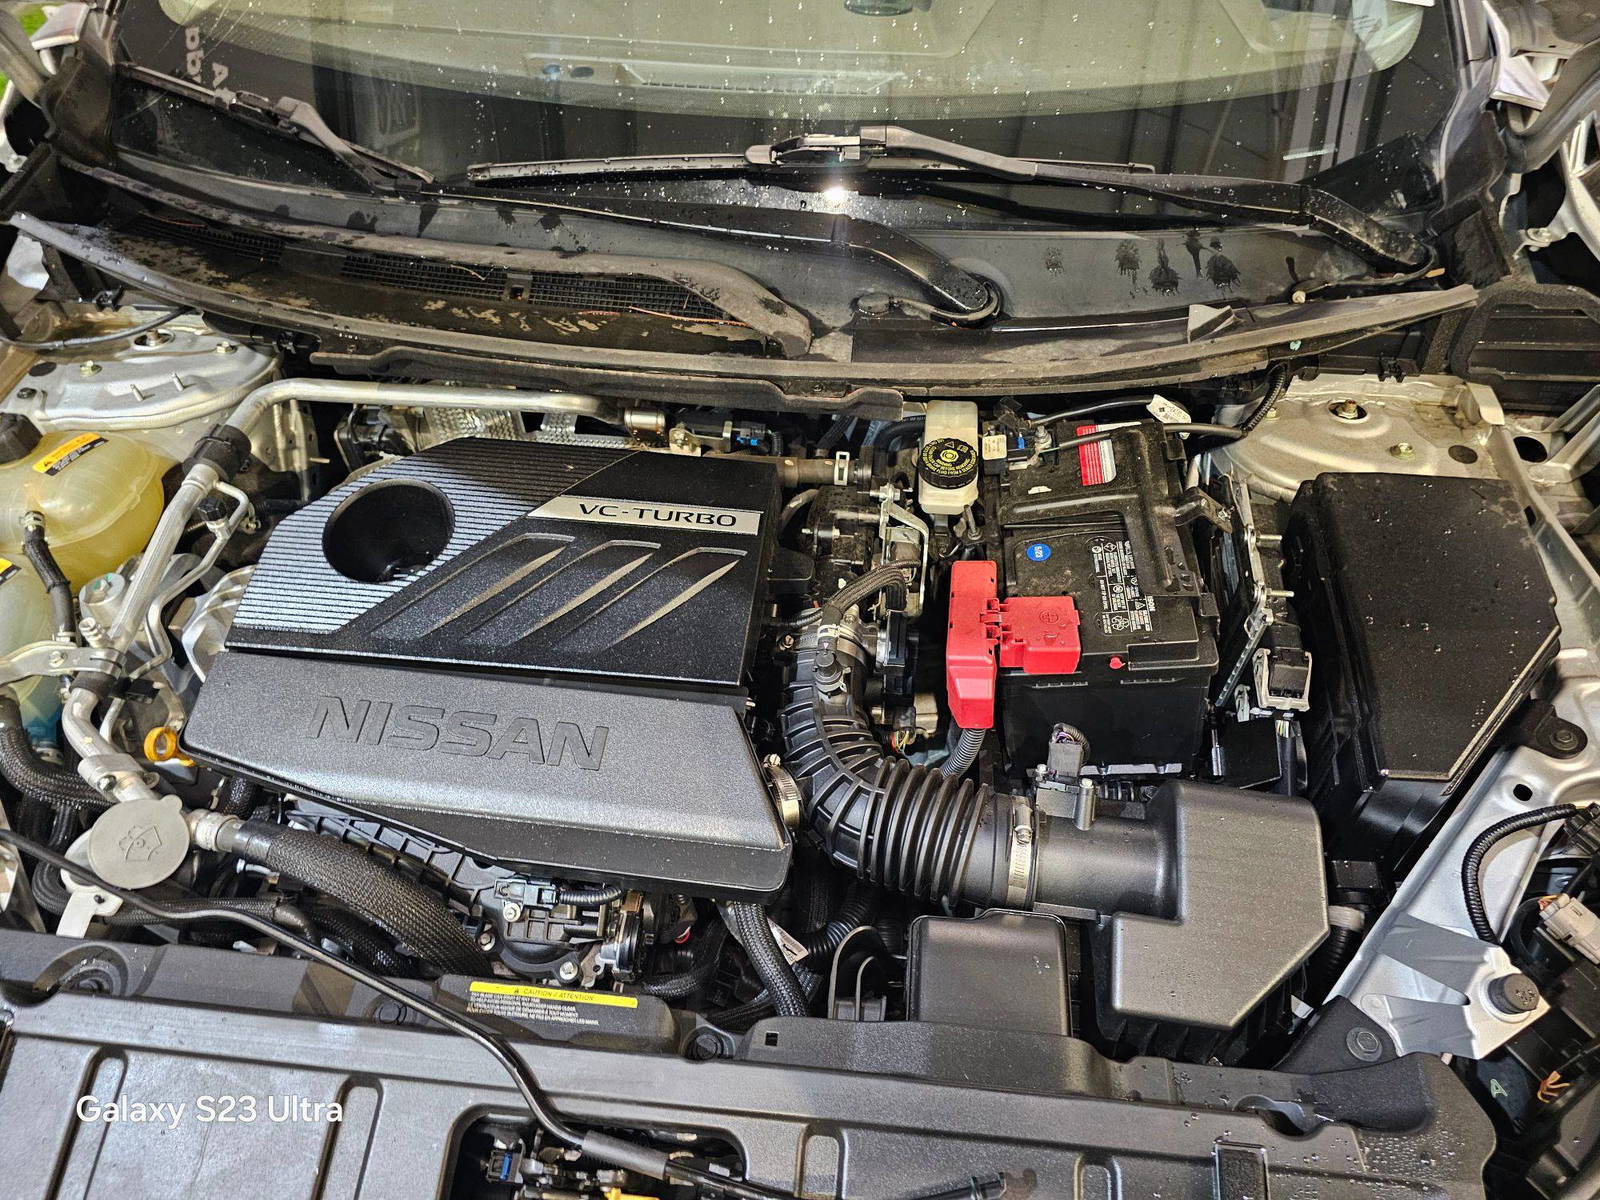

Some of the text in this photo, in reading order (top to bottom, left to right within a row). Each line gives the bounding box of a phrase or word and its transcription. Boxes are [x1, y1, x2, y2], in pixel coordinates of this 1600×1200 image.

[579, 503, 737, 527] VC-TURBO
[304, 695, 610, 772] NISSAN
[523, 987, 553, 997] CAUTION
[558, 991, 595, 1001] ATTENTION
